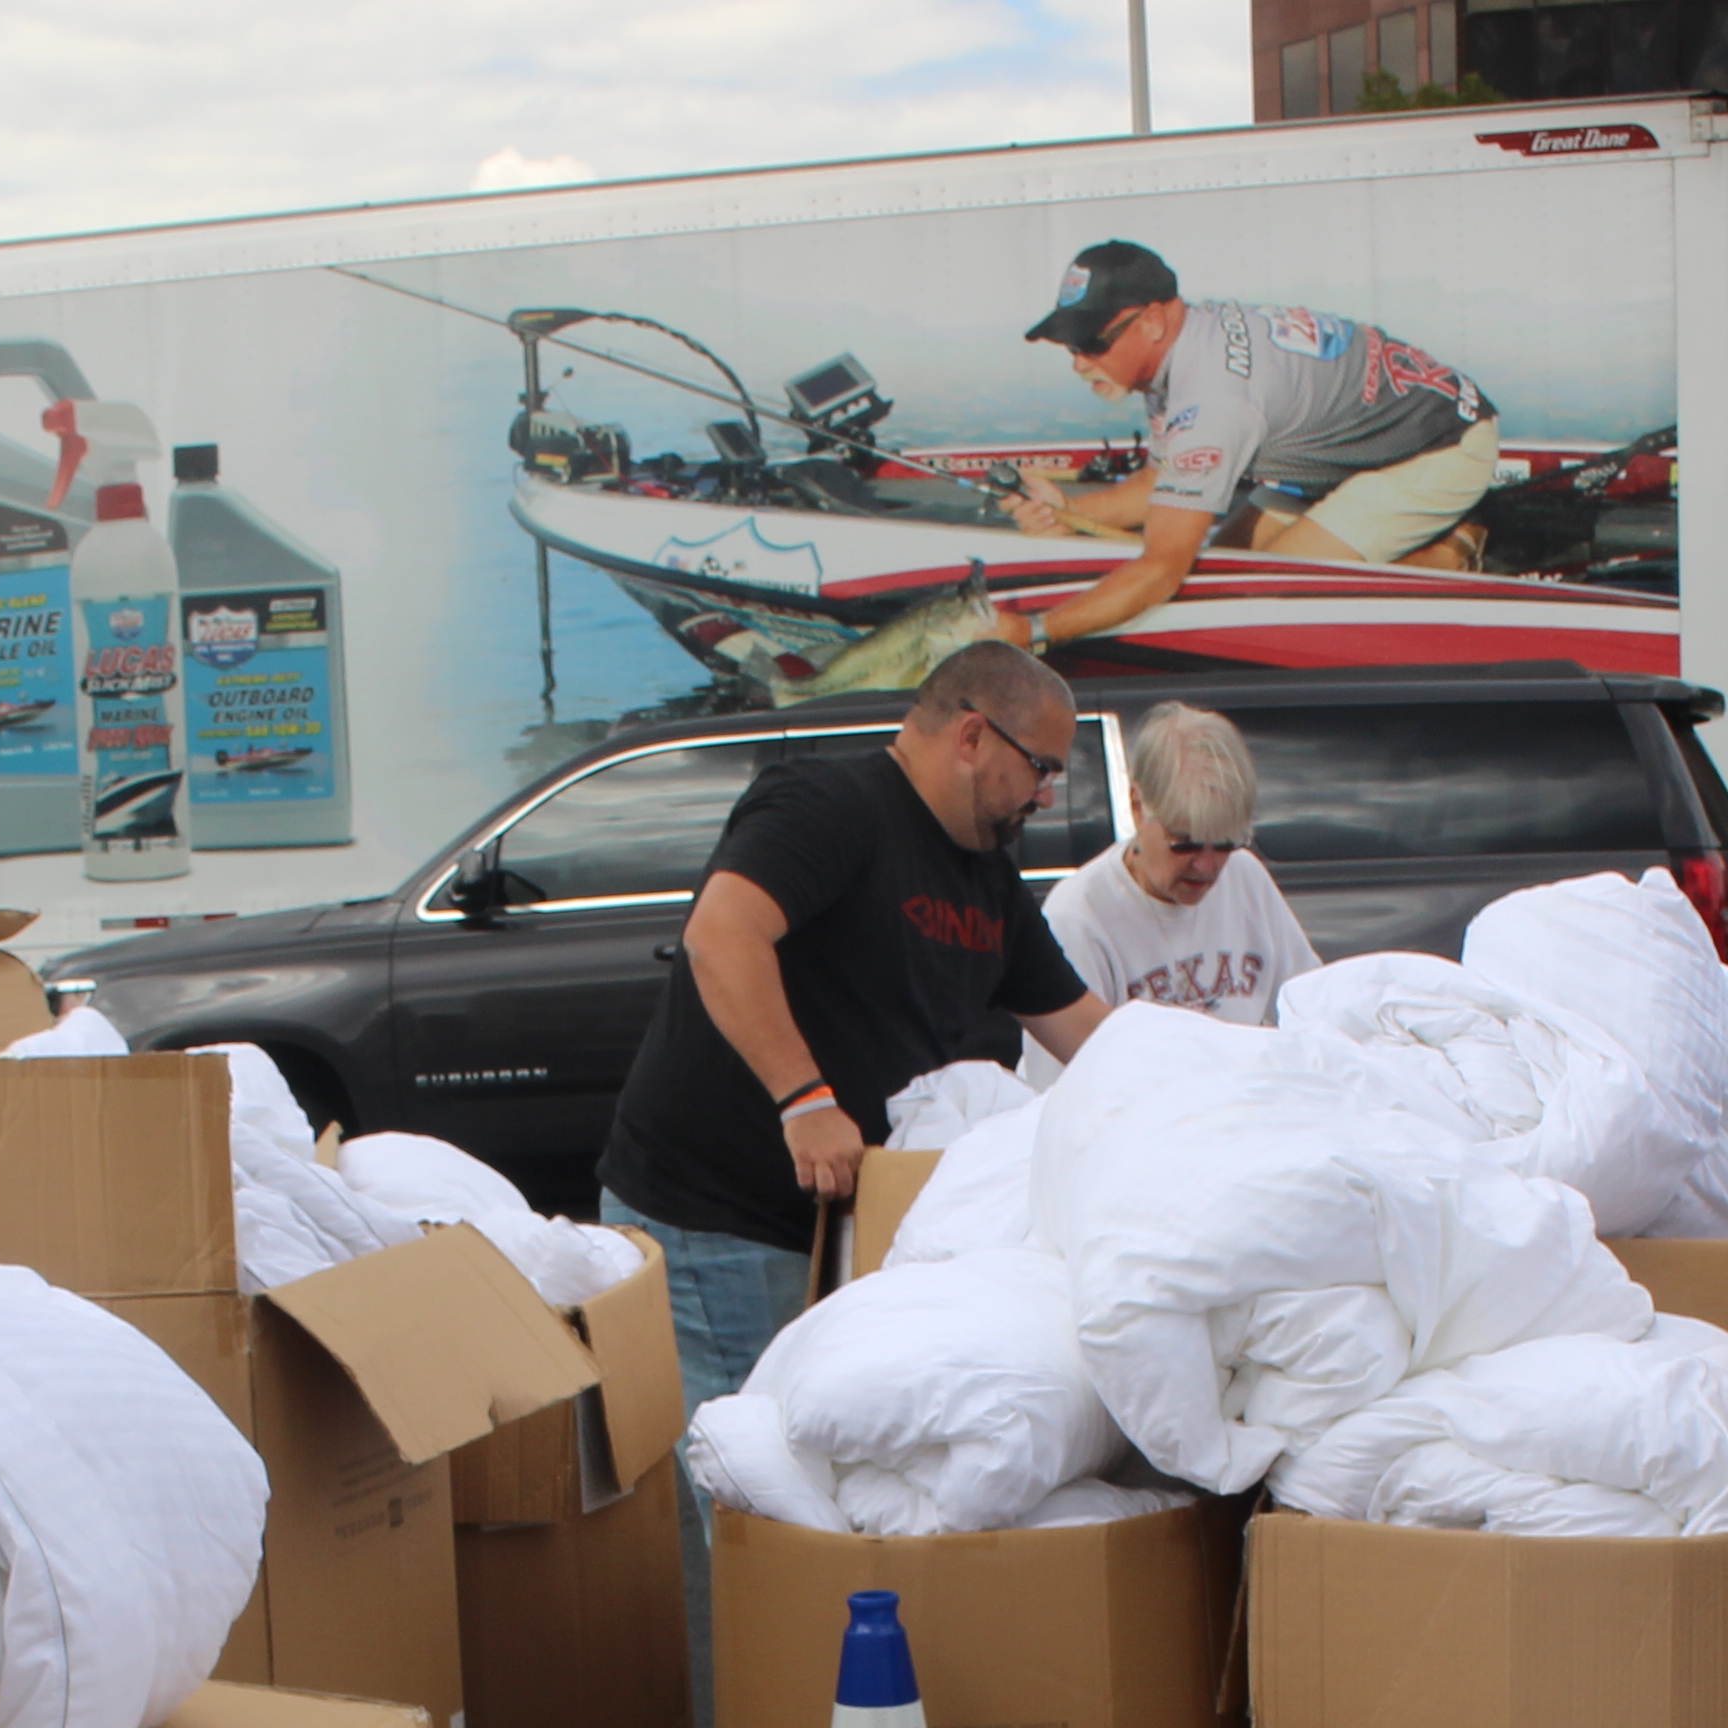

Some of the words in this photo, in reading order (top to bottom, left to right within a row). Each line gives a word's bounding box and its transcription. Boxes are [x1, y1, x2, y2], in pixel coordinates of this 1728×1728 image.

[1531, 132, 1583, 152] Great
[1583, 128, 1631, 149] Dane
[27, 641, 58, 658] OIL
[85, 644, 175, 678] LUCAS
[208, 686, 315, 707] OUTBOARD
[100, 707, 159, 724] MARINE
[212, 709, 277, 724] ENGINE
[282, 708, 309, 721] OIL
[1127, 951, 1264, 1001] TEXAS
